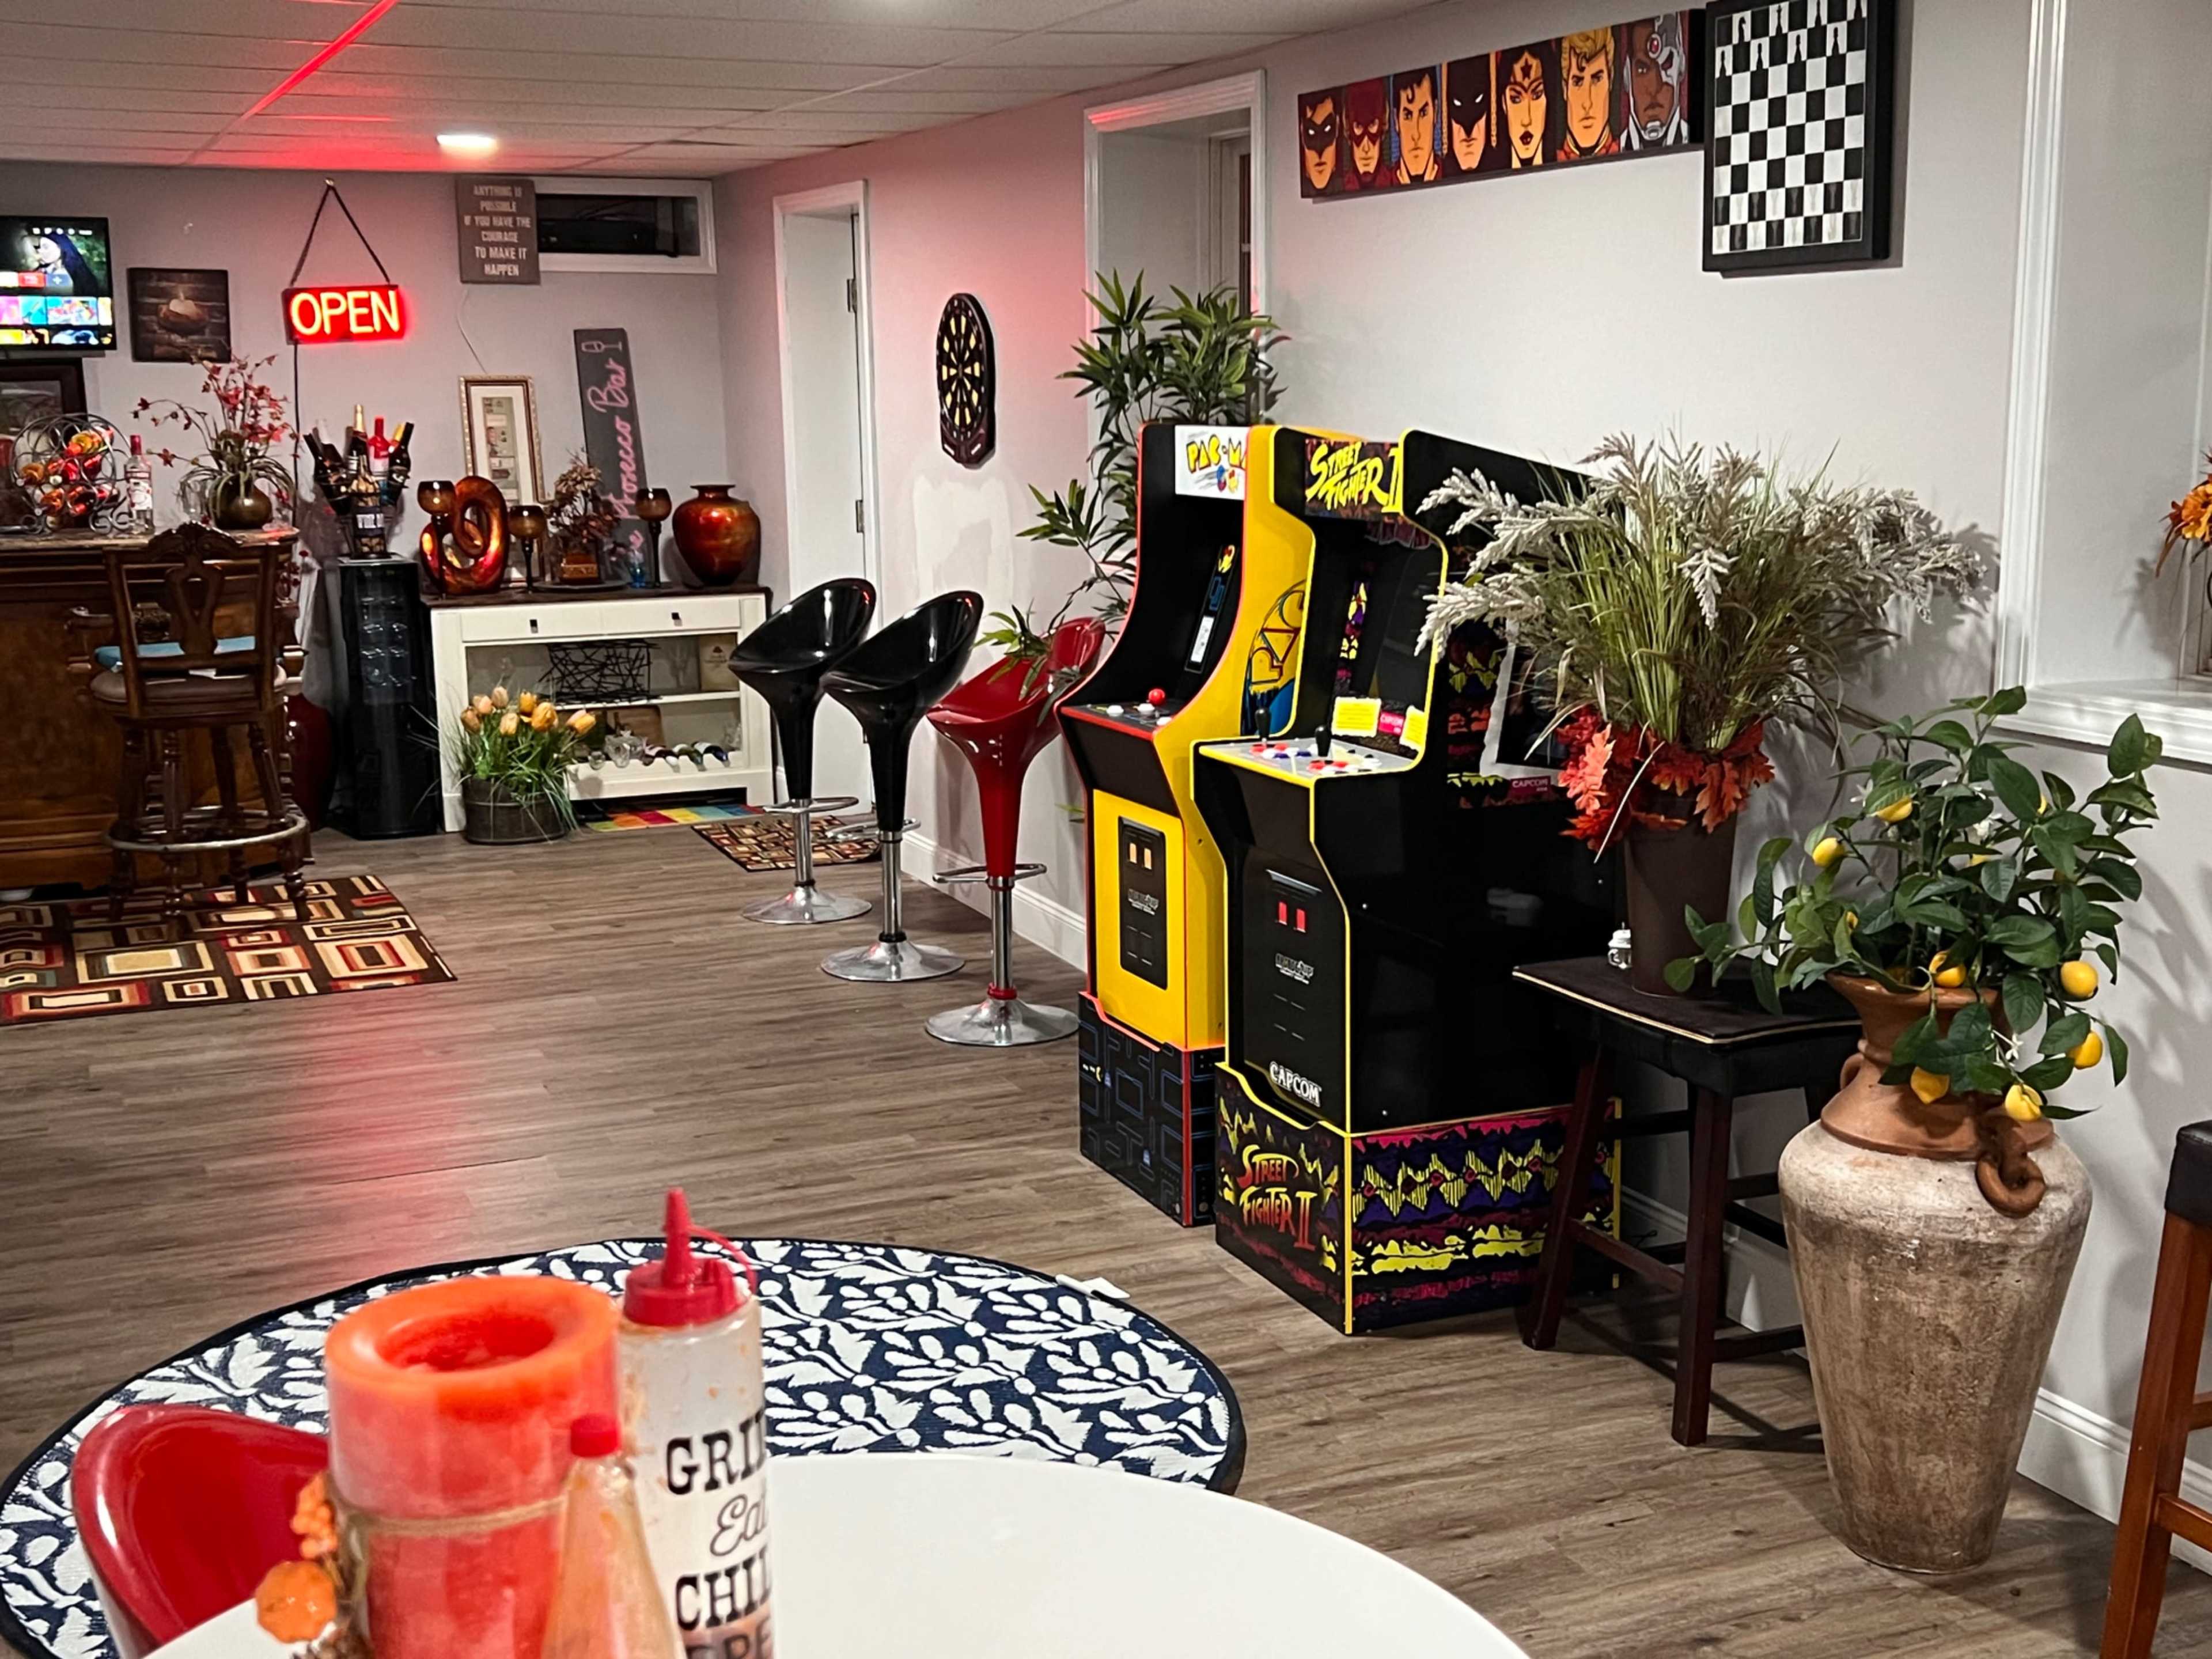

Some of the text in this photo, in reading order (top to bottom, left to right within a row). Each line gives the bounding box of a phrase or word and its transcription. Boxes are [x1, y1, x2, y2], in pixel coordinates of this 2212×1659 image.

[492, 217, 513, 228] HAVE
[516, 217, 531, 228] THE
[475, 246, 527, 259] TO MAKE IT
[484, 263, 519, 276] HAPPEN
[290, 290, 400, 335] OPEN
[587, 357, 630, 413] Bar
[1305, 441, 1362, 502] STREET
[1317, 456, 1389, 511] FIGHTER
[1512, 778, 1548, 789] CAPCOM
[1270, 1061, 1321, 1107] CAPCOM
[1237, 1144, 1300, 1189] STREET
[1240, 1185, 1318, 1251] FIGHTER II
